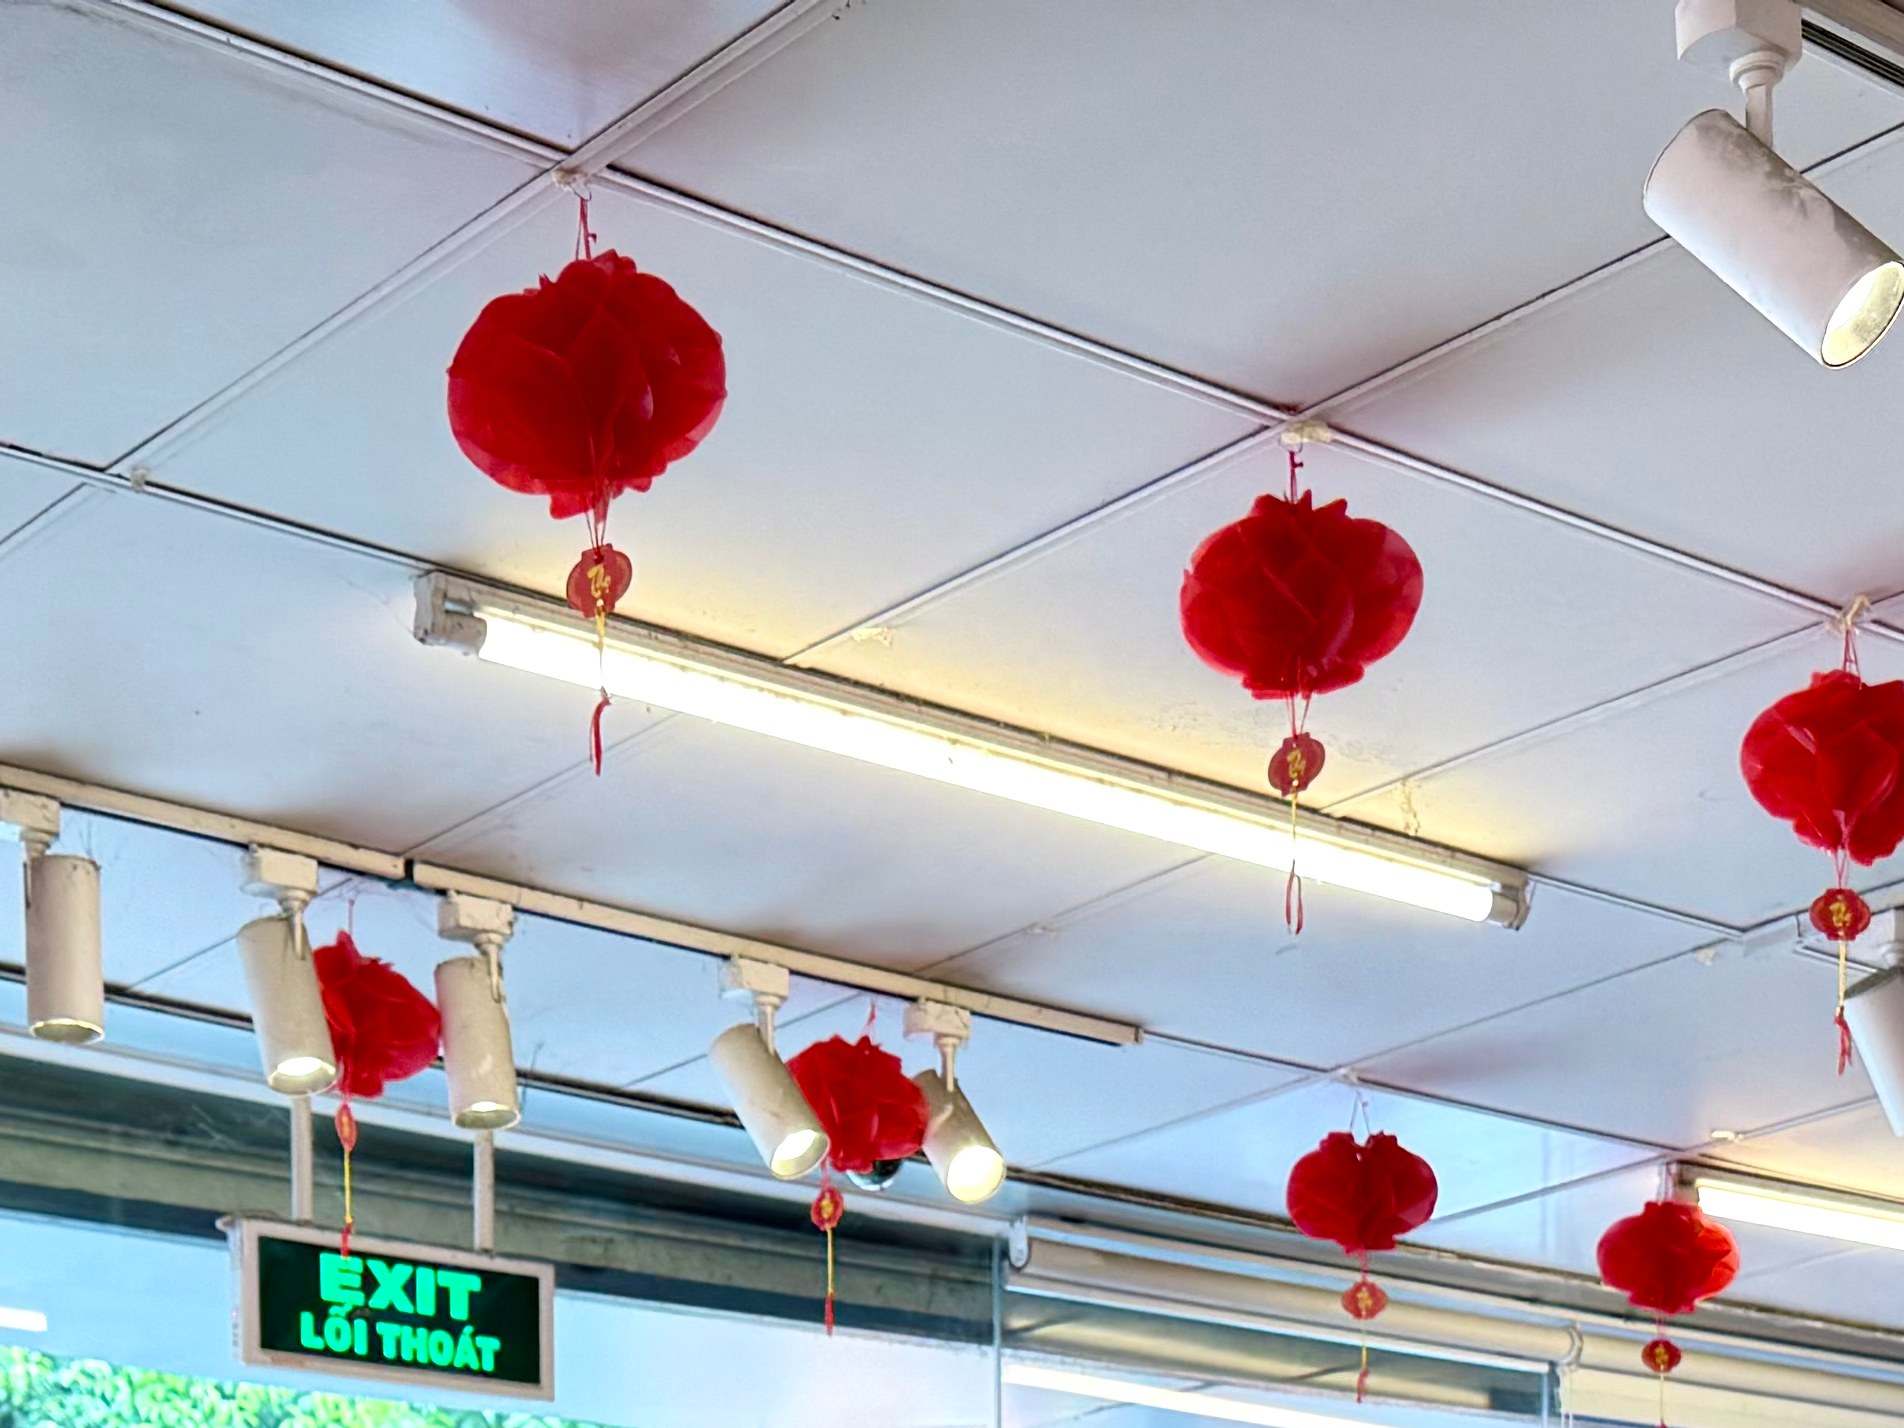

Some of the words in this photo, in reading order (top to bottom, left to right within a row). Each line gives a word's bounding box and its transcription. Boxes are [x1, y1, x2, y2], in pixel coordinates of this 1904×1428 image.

[319, 1252, 481, 1321] EXIT
[300, 1304, 368, 1355] LỐI
[375, 1325, 501, 1373] THOÁT
